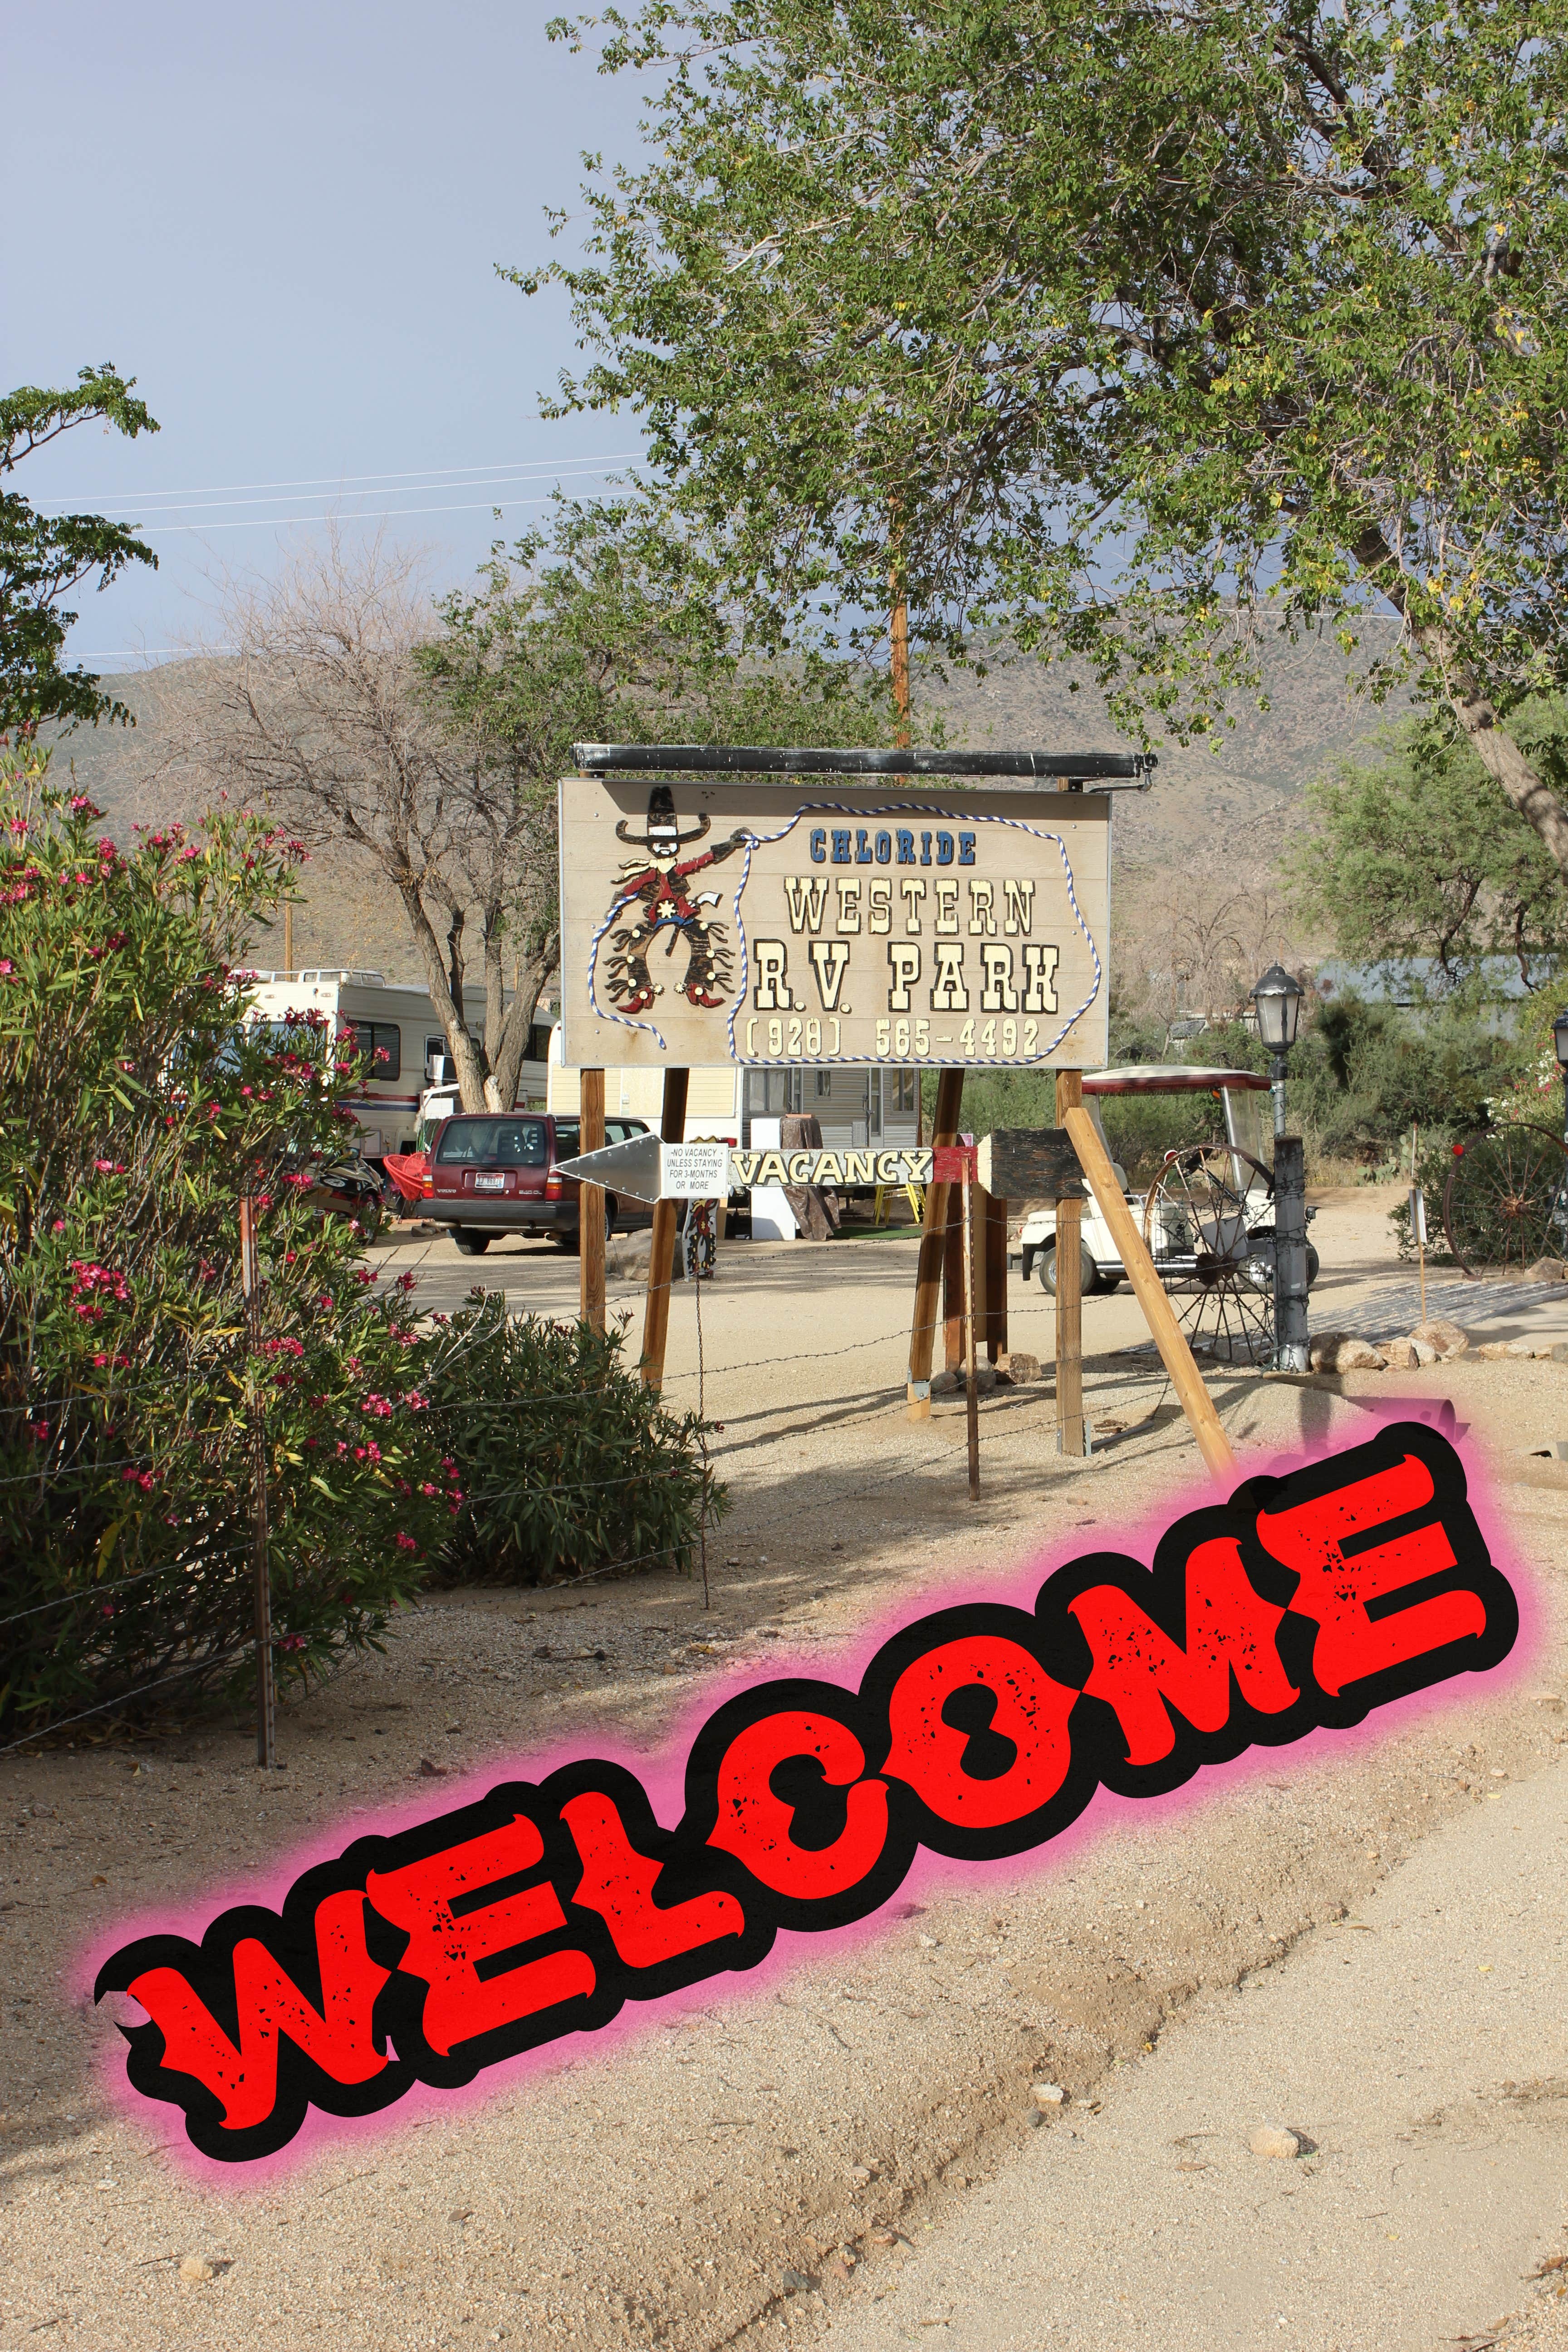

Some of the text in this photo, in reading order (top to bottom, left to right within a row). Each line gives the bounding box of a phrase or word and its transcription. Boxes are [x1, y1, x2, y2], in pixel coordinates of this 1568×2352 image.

[810, 828, 976, 866] CHLORIDE
[784, 876, 1035, 936] WESTERN
[753, 938, 1059, 1015] R.V. PARK
[746, 1018, 1039, 1057] (928) 565-4492
[667, 1159, 722, 1167] UNLESS STAYING
[685, 1148, 717, 1156] VACANCY
[731, 1150, 933, 1185] VACANCY
[670, 1170, 718, 1178] FOR 3-MONTHS
[676, 1181, 709, 1190] OR MORE
